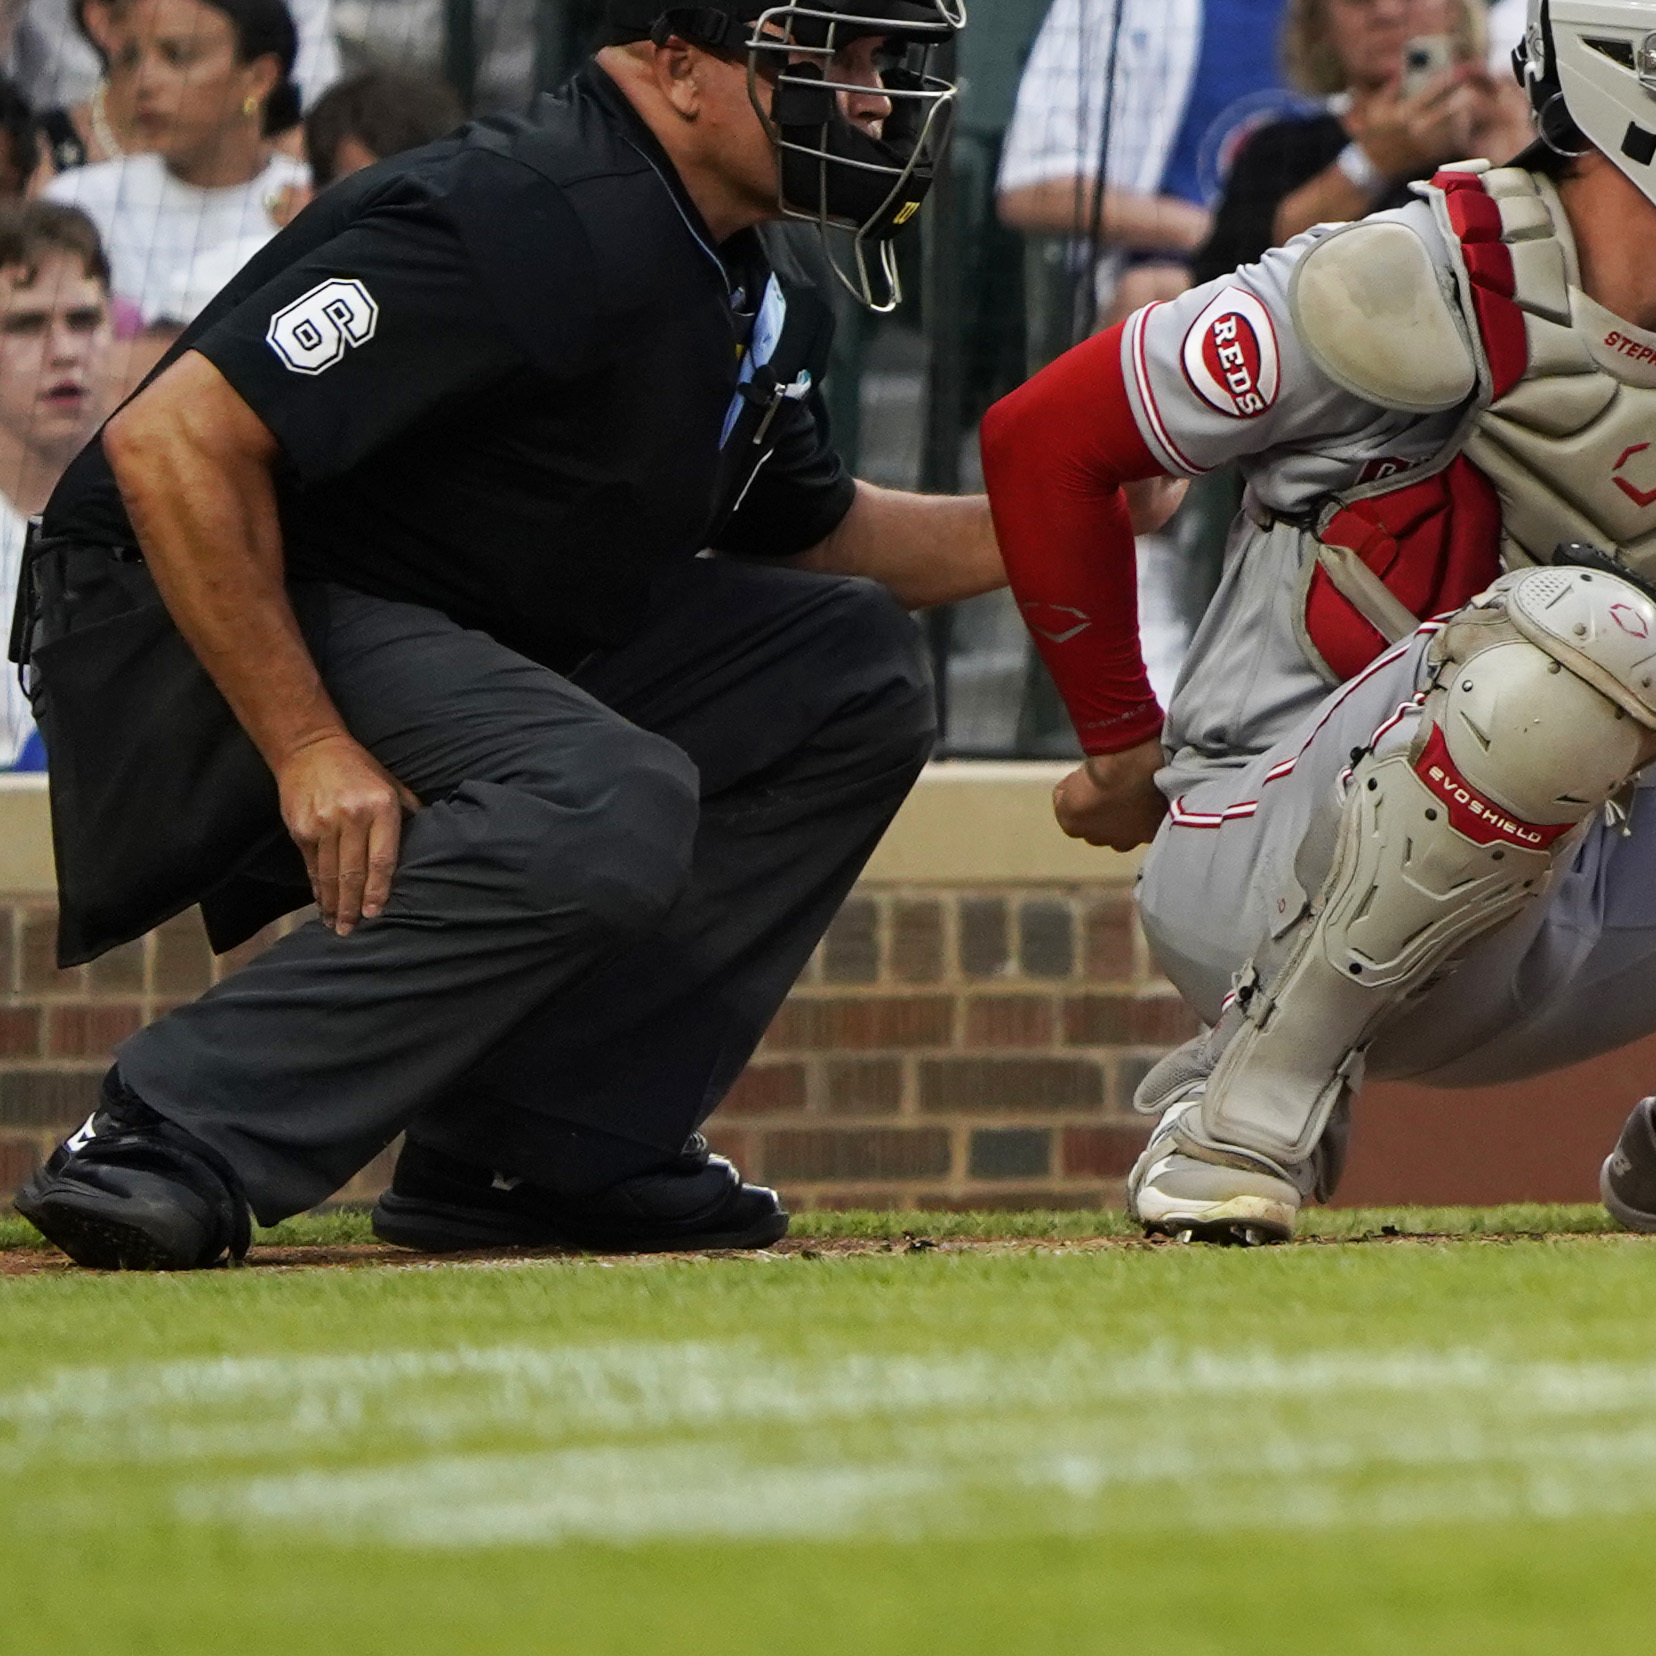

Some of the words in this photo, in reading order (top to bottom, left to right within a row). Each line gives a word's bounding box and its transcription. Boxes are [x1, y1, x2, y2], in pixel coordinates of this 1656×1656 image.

[266, 277, 379, 376] 6
[1211, 315, 1268, 417] REDS
[1428, 765, 1542, 844] EVOSHIELD
